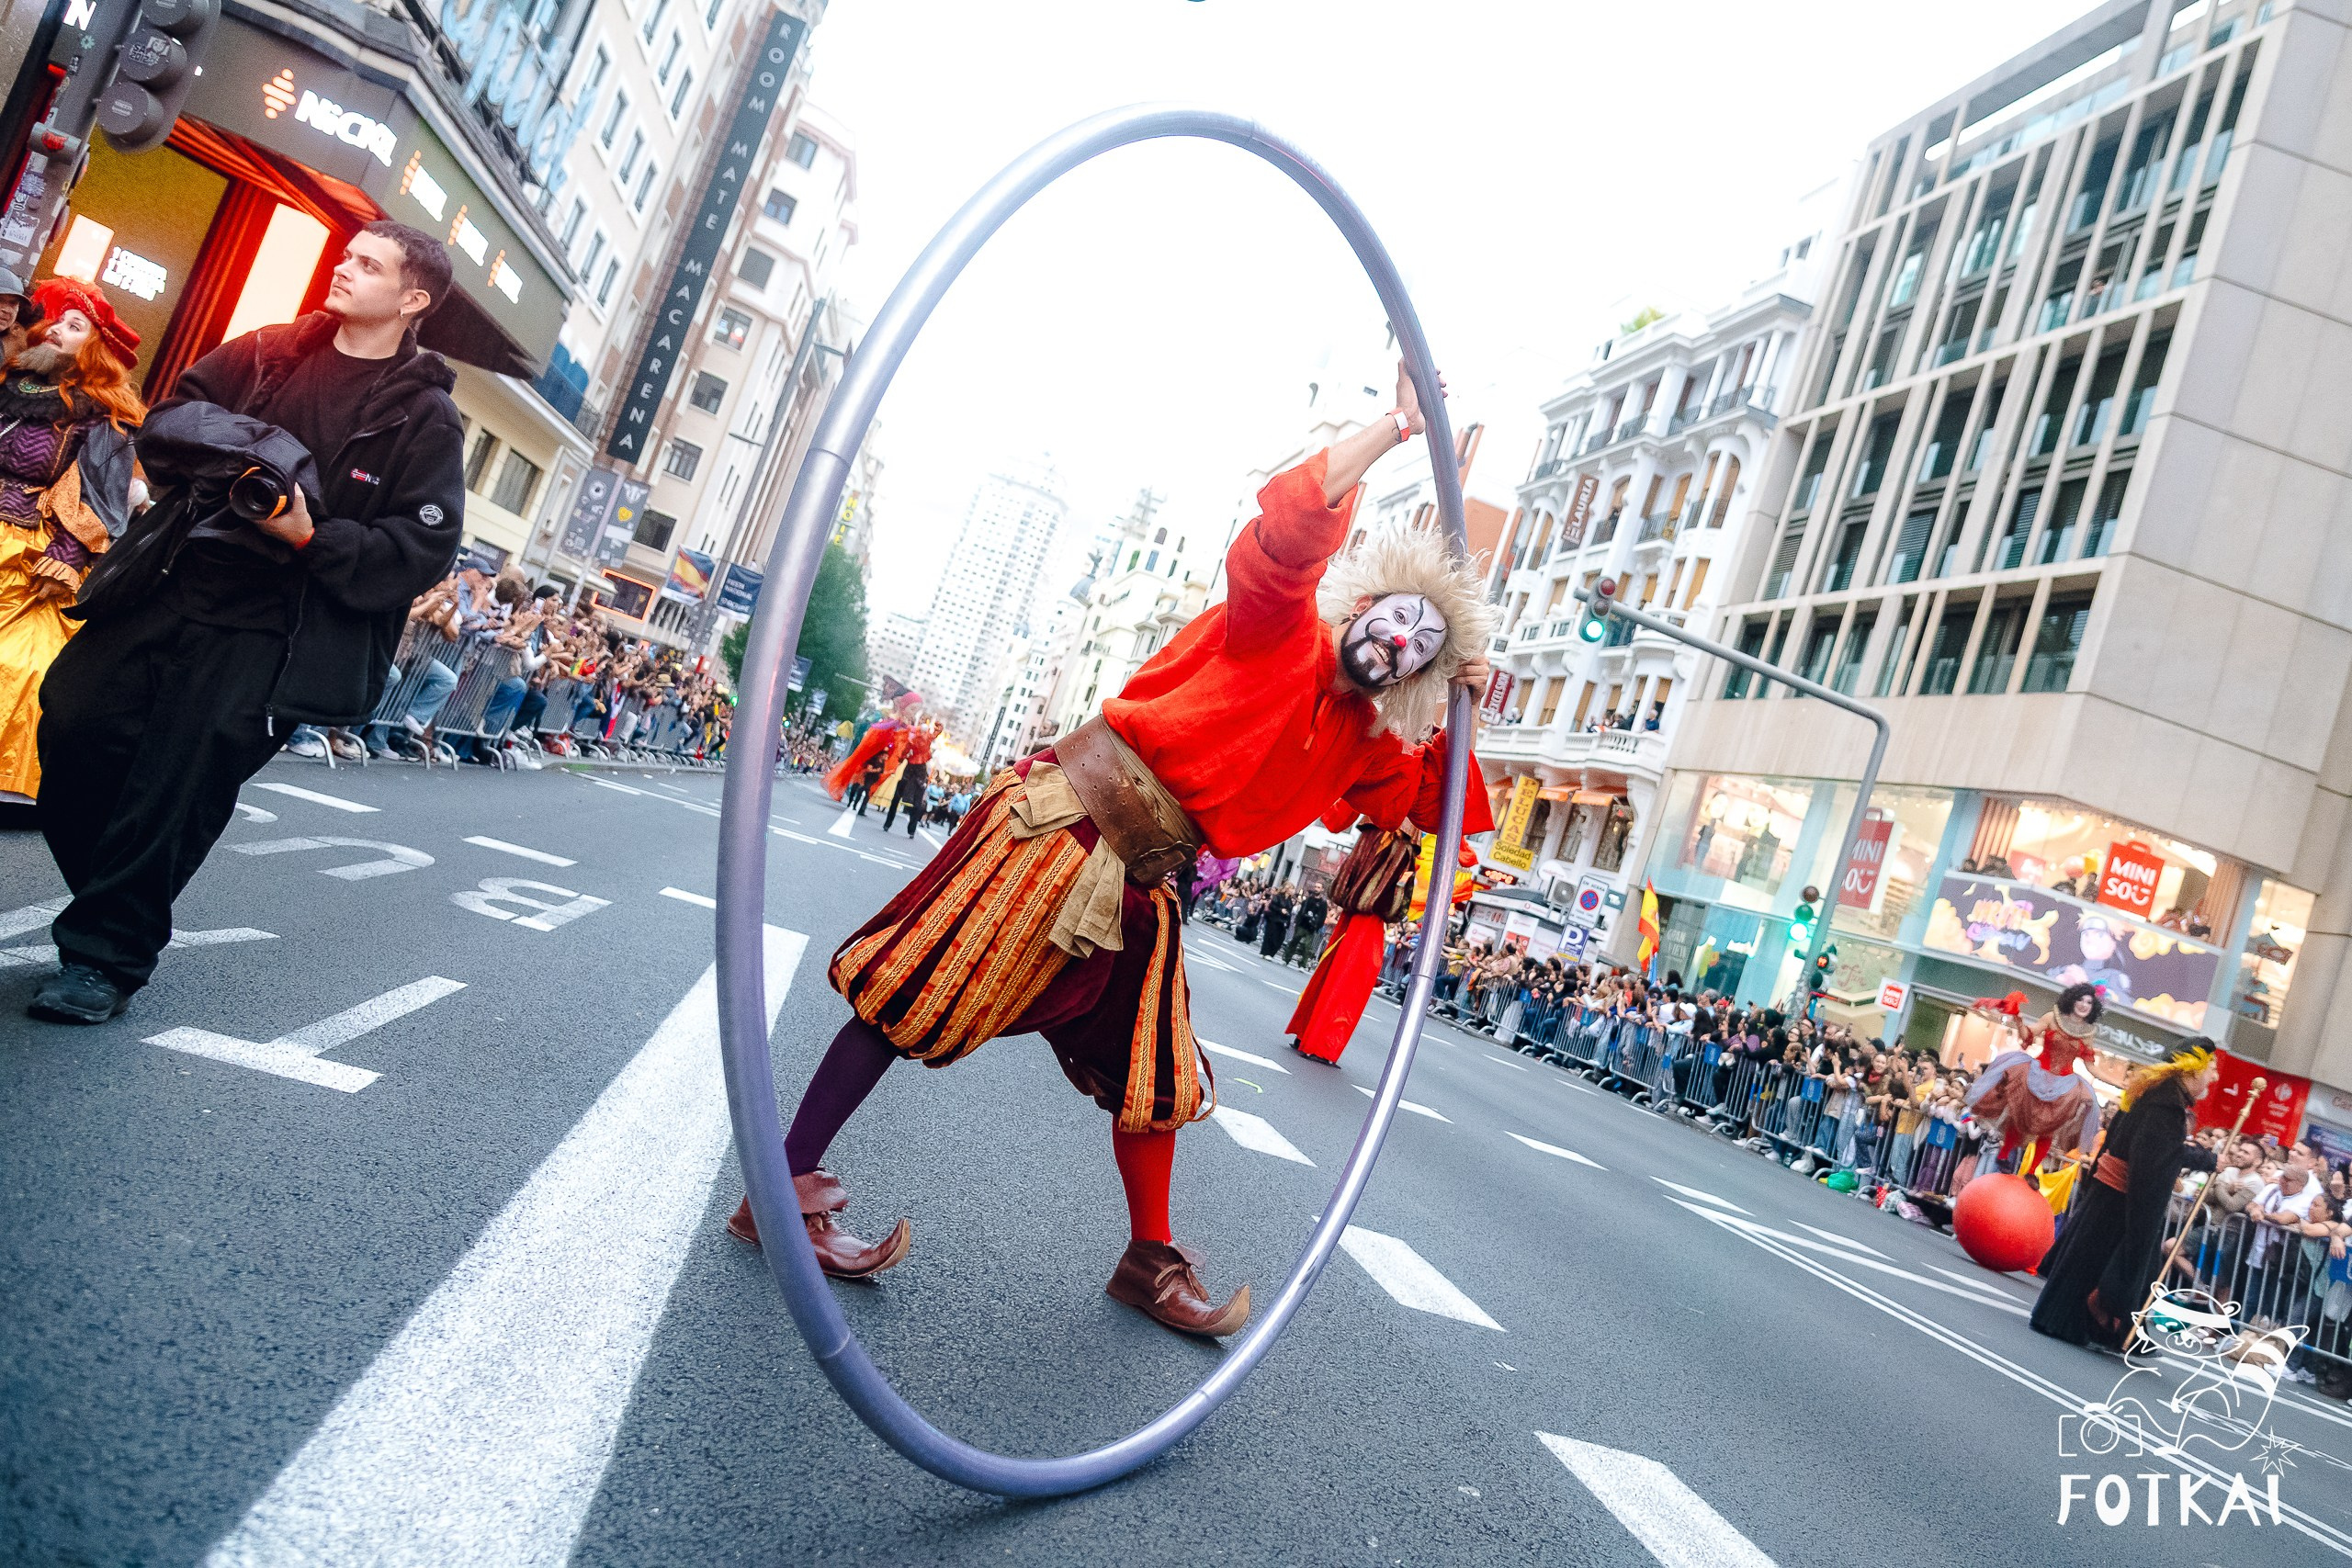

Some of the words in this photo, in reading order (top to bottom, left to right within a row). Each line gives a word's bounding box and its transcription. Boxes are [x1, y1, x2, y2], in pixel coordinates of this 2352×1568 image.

[748, 22, 792, 114] ROOM
[706, 141, 748, 230] MATE
[618, 258, 703, 450] MACARENA
[1573, 478, 1595, 526] LAURIA
[1488, 671, 1512, 713] EXCELSIOR
[1505, 779, 1536, 842] PELUCAS
[1493, 851, 1527, 869] Cabello
[1495, 840, 1532, 861] Soledad
[2110, 856, 2156, 886] MINI
[1560, 925, 1583, 949] P
